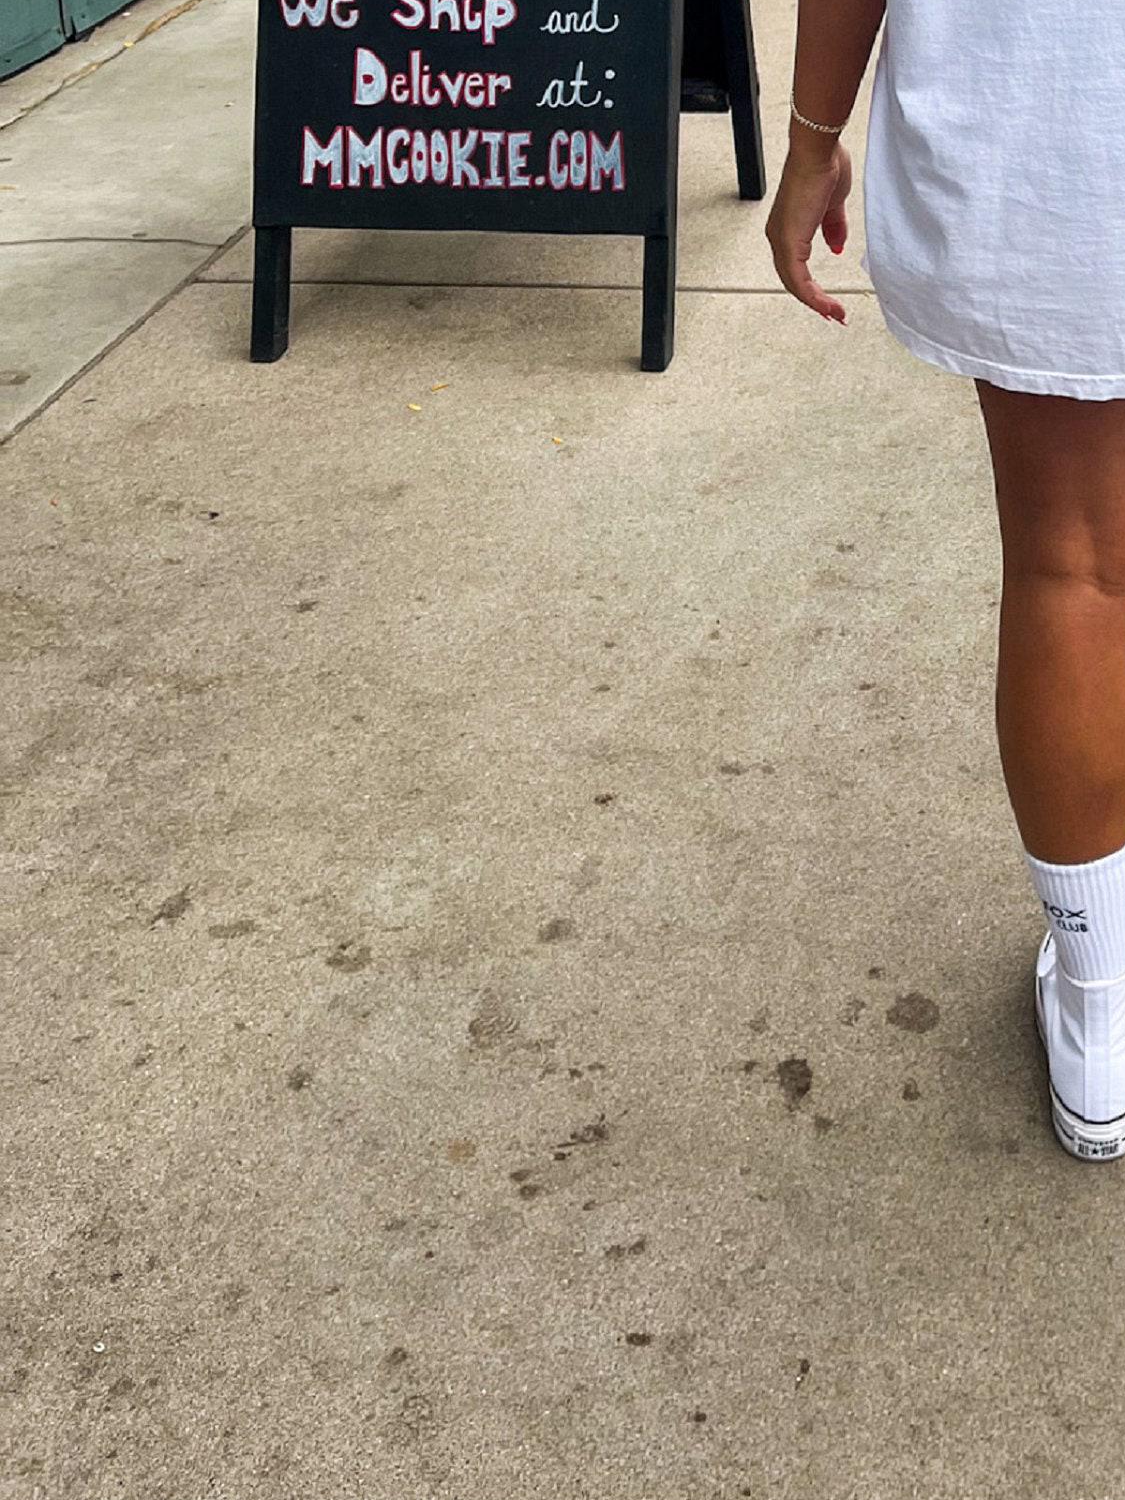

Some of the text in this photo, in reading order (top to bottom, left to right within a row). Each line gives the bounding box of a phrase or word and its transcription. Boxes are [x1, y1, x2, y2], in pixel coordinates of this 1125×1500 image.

[353, 46, 617, 109] Deliver at:
[300, 124, 627, 192] MMCOOKIE.COM
